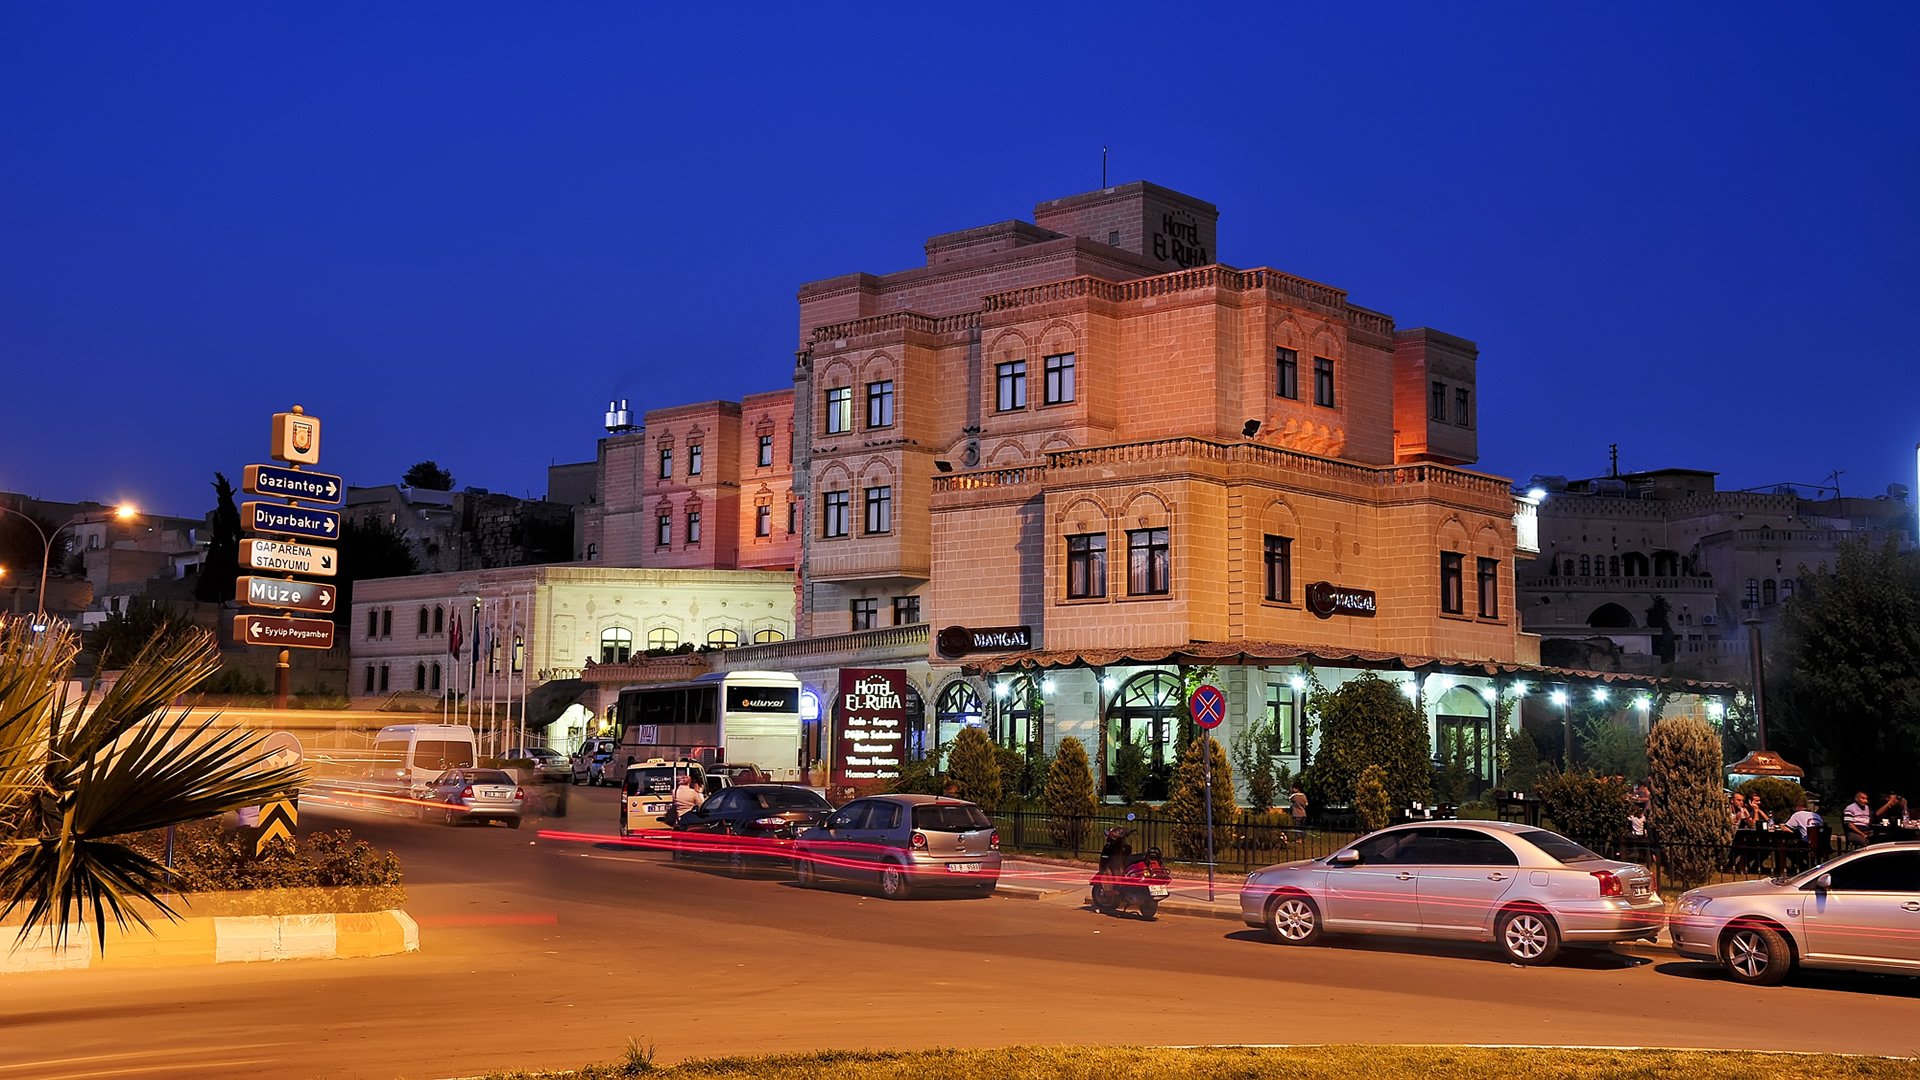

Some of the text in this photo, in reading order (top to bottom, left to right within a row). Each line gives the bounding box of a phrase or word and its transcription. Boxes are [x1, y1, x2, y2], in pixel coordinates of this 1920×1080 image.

[1163, 214, 1201, 246] HOTEL
[1172, 239, 1207, 268] RUHA
[260, 473, 323, 495] Gaziantep
[256, 510, 320, 529] Diyarbakır
[255, 541, 312, 557] GAP ARENA
[256, 556, 310, 571] STADYUMU
[251, 582, 301, 603] Müze
[289, 628, 329, 639] Peygamber
[973, 632, 1029, 647] MANGAL
[855, 680, 894, 697] HOTEL
[750, 699, 785, 707] uluyol
